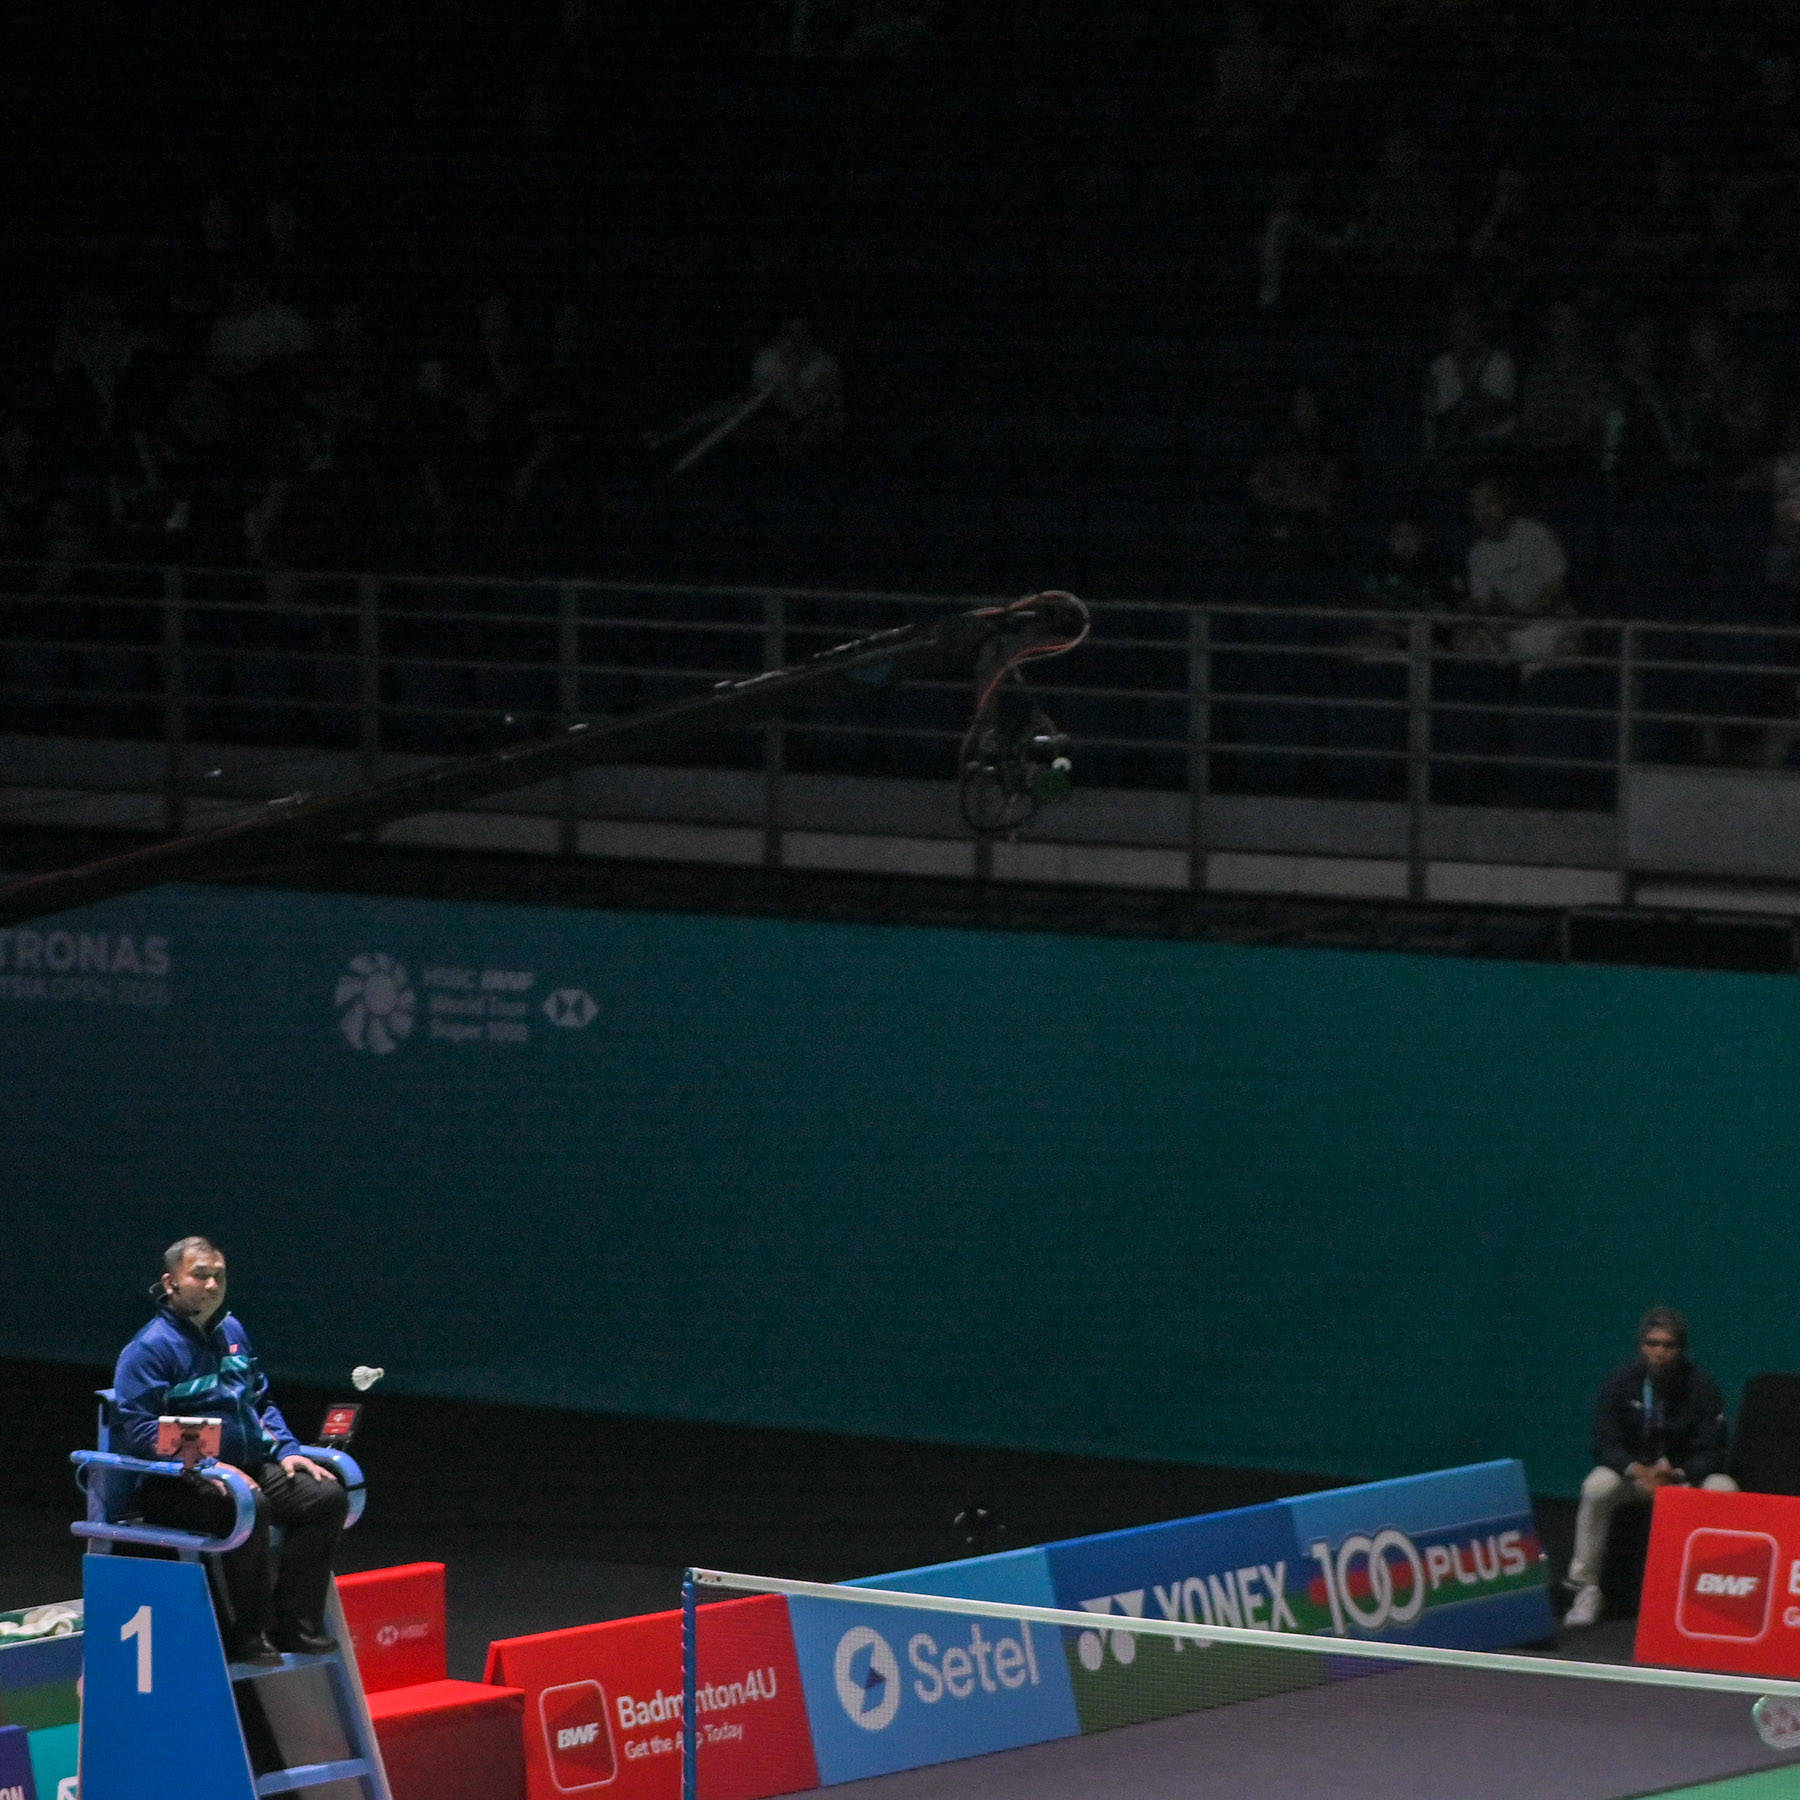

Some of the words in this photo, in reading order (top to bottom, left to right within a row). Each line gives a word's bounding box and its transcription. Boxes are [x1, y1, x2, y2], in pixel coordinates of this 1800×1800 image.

[1153, 1560, 1297, 1654] YONEX
[1696, 1572, 1759, 1597] BWF
[120, 1604, 153, 1695] 1
[908, 1619, 1041, 1704] Setel
[617, 1666, 778, 1730] Badmnton4U
[557, 1722, 599, 1750] BWF
[624, 1739, 649, 1760] Get
[650, 1734, 674, 1754] the
